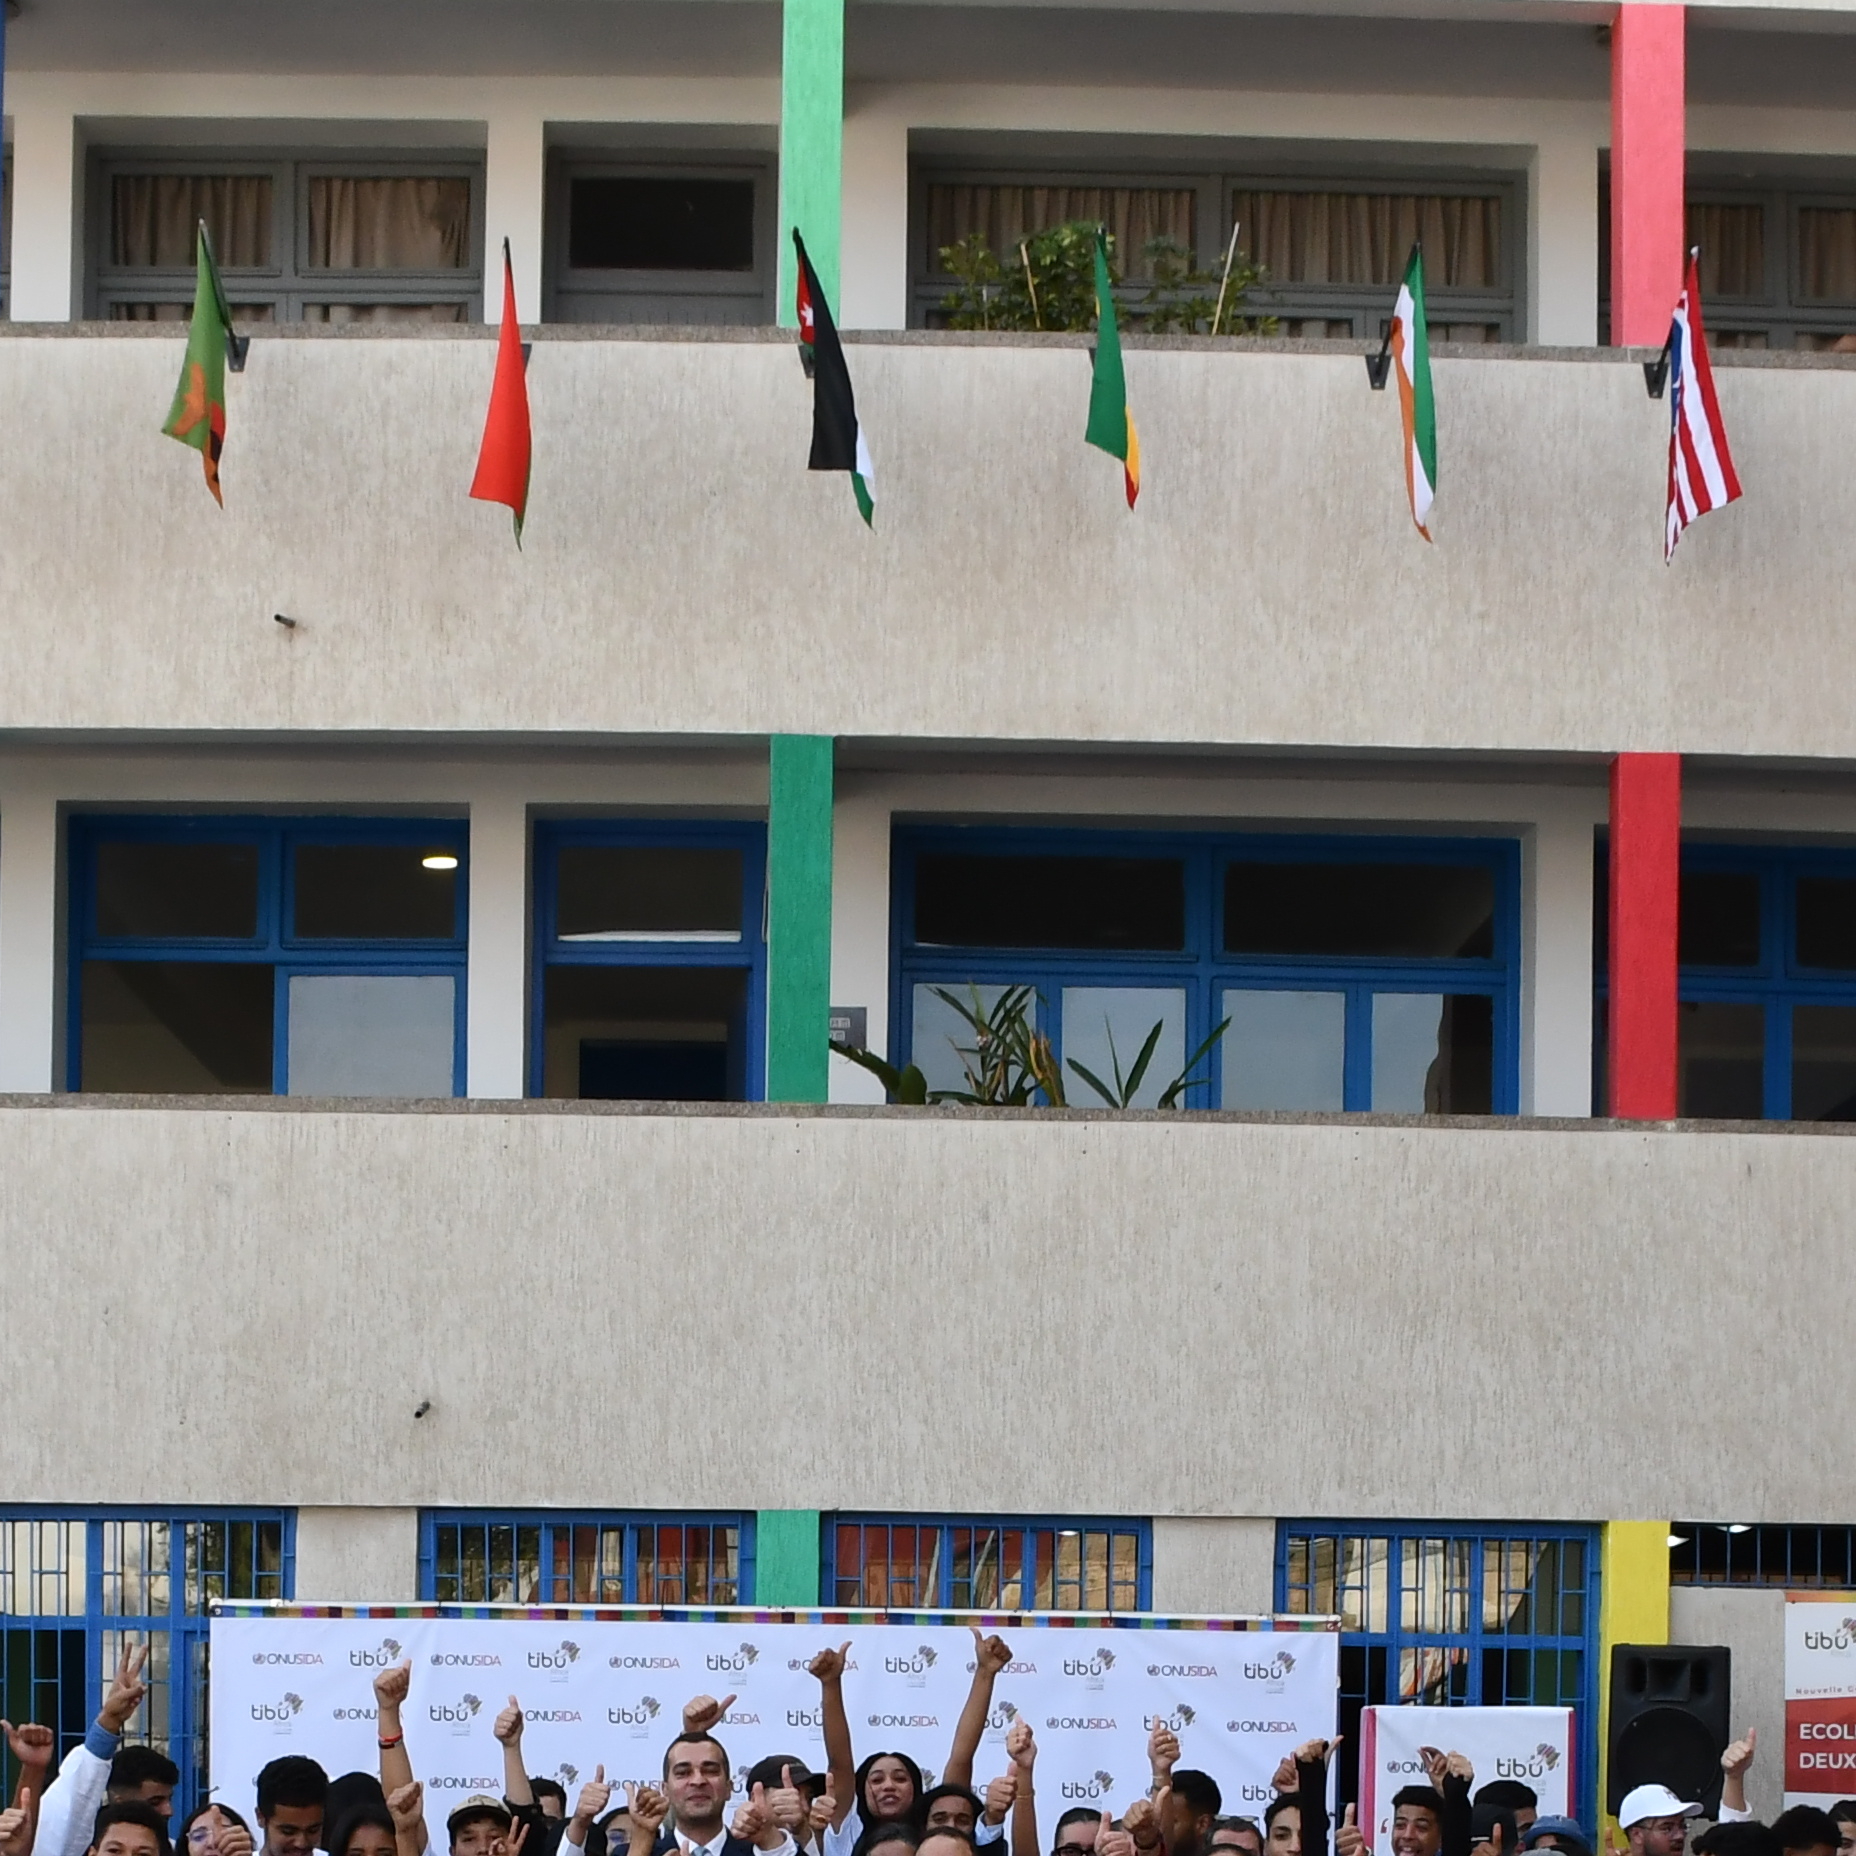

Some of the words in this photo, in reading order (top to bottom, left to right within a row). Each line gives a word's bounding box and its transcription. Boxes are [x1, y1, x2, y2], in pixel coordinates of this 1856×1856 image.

[1805, 1631, 1848, 1650] tibu
[267, 1653, 324, 1665] ONUSIDA
[444, 1654, 502, 1666] ONUSIDA
[624, 1656, 680, 1668] ONUSIDA
[1161, 1665, 1218, 1677] ONUSIDA
[1796, 1686, 1842, 1695] Nouvelle
[882, 1715, 939, 1727] ONUSIDA
[1060, 1717, 1117, 1730] ONUSIDA
[1240, 1720, 1297, 1733] ONUSIDA
[443, 1777, 500, 1789] ONUSIDA
